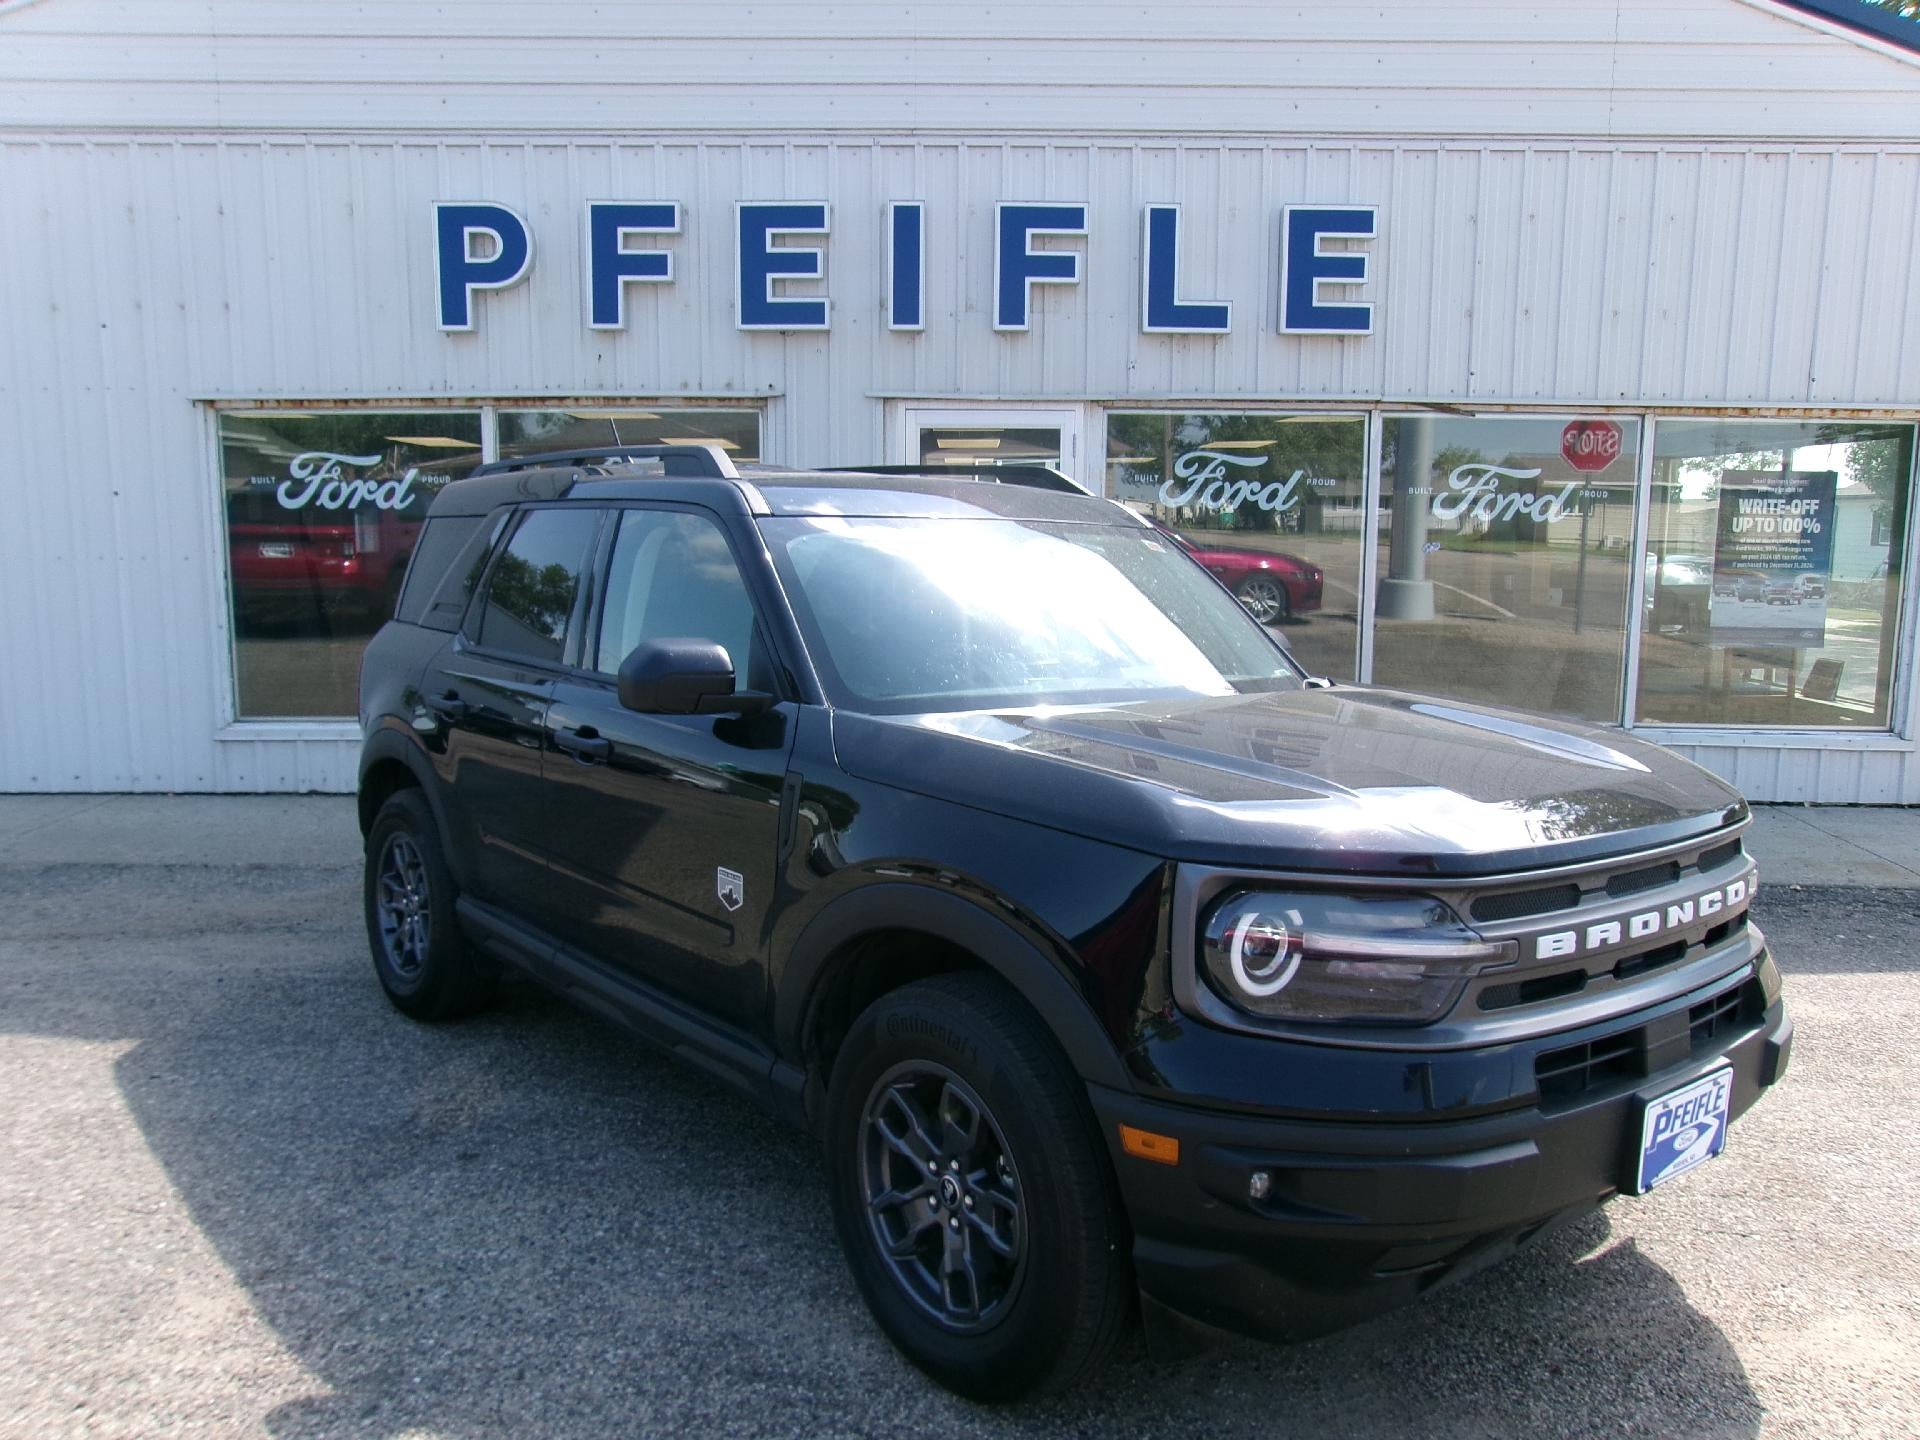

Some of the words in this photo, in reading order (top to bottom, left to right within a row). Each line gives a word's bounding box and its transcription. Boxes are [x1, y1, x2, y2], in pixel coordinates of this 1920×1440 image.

[432, 200, 1379, 336] PFEIFLE
[251, 476, 276, 485] BUILT
[277, 452, 419, 510] Ford
[422, 475, 451, 484] PROUD
[1134, 474, 1159, 482] BUILT
[1158, 451, 1304, 511] Ford
[1306, 478, 1336, 486] PROUD
[1408, 487, 1433, 495] BUILT
[1432, 463, 1576, 523] Ford
[1579, 490, 1608, 498] PROUD
[1738, 498, 1820, 515] WRITE-OFF
[1732, 517, 1754, 533] UP
[1755, 517, 1775, 533] TO
[1776, 517, 1821, 534] 100%
[1536, 880, 1745, 960] BRONCO
[1651, 1085, 1726, 1152] PFEIFLE
